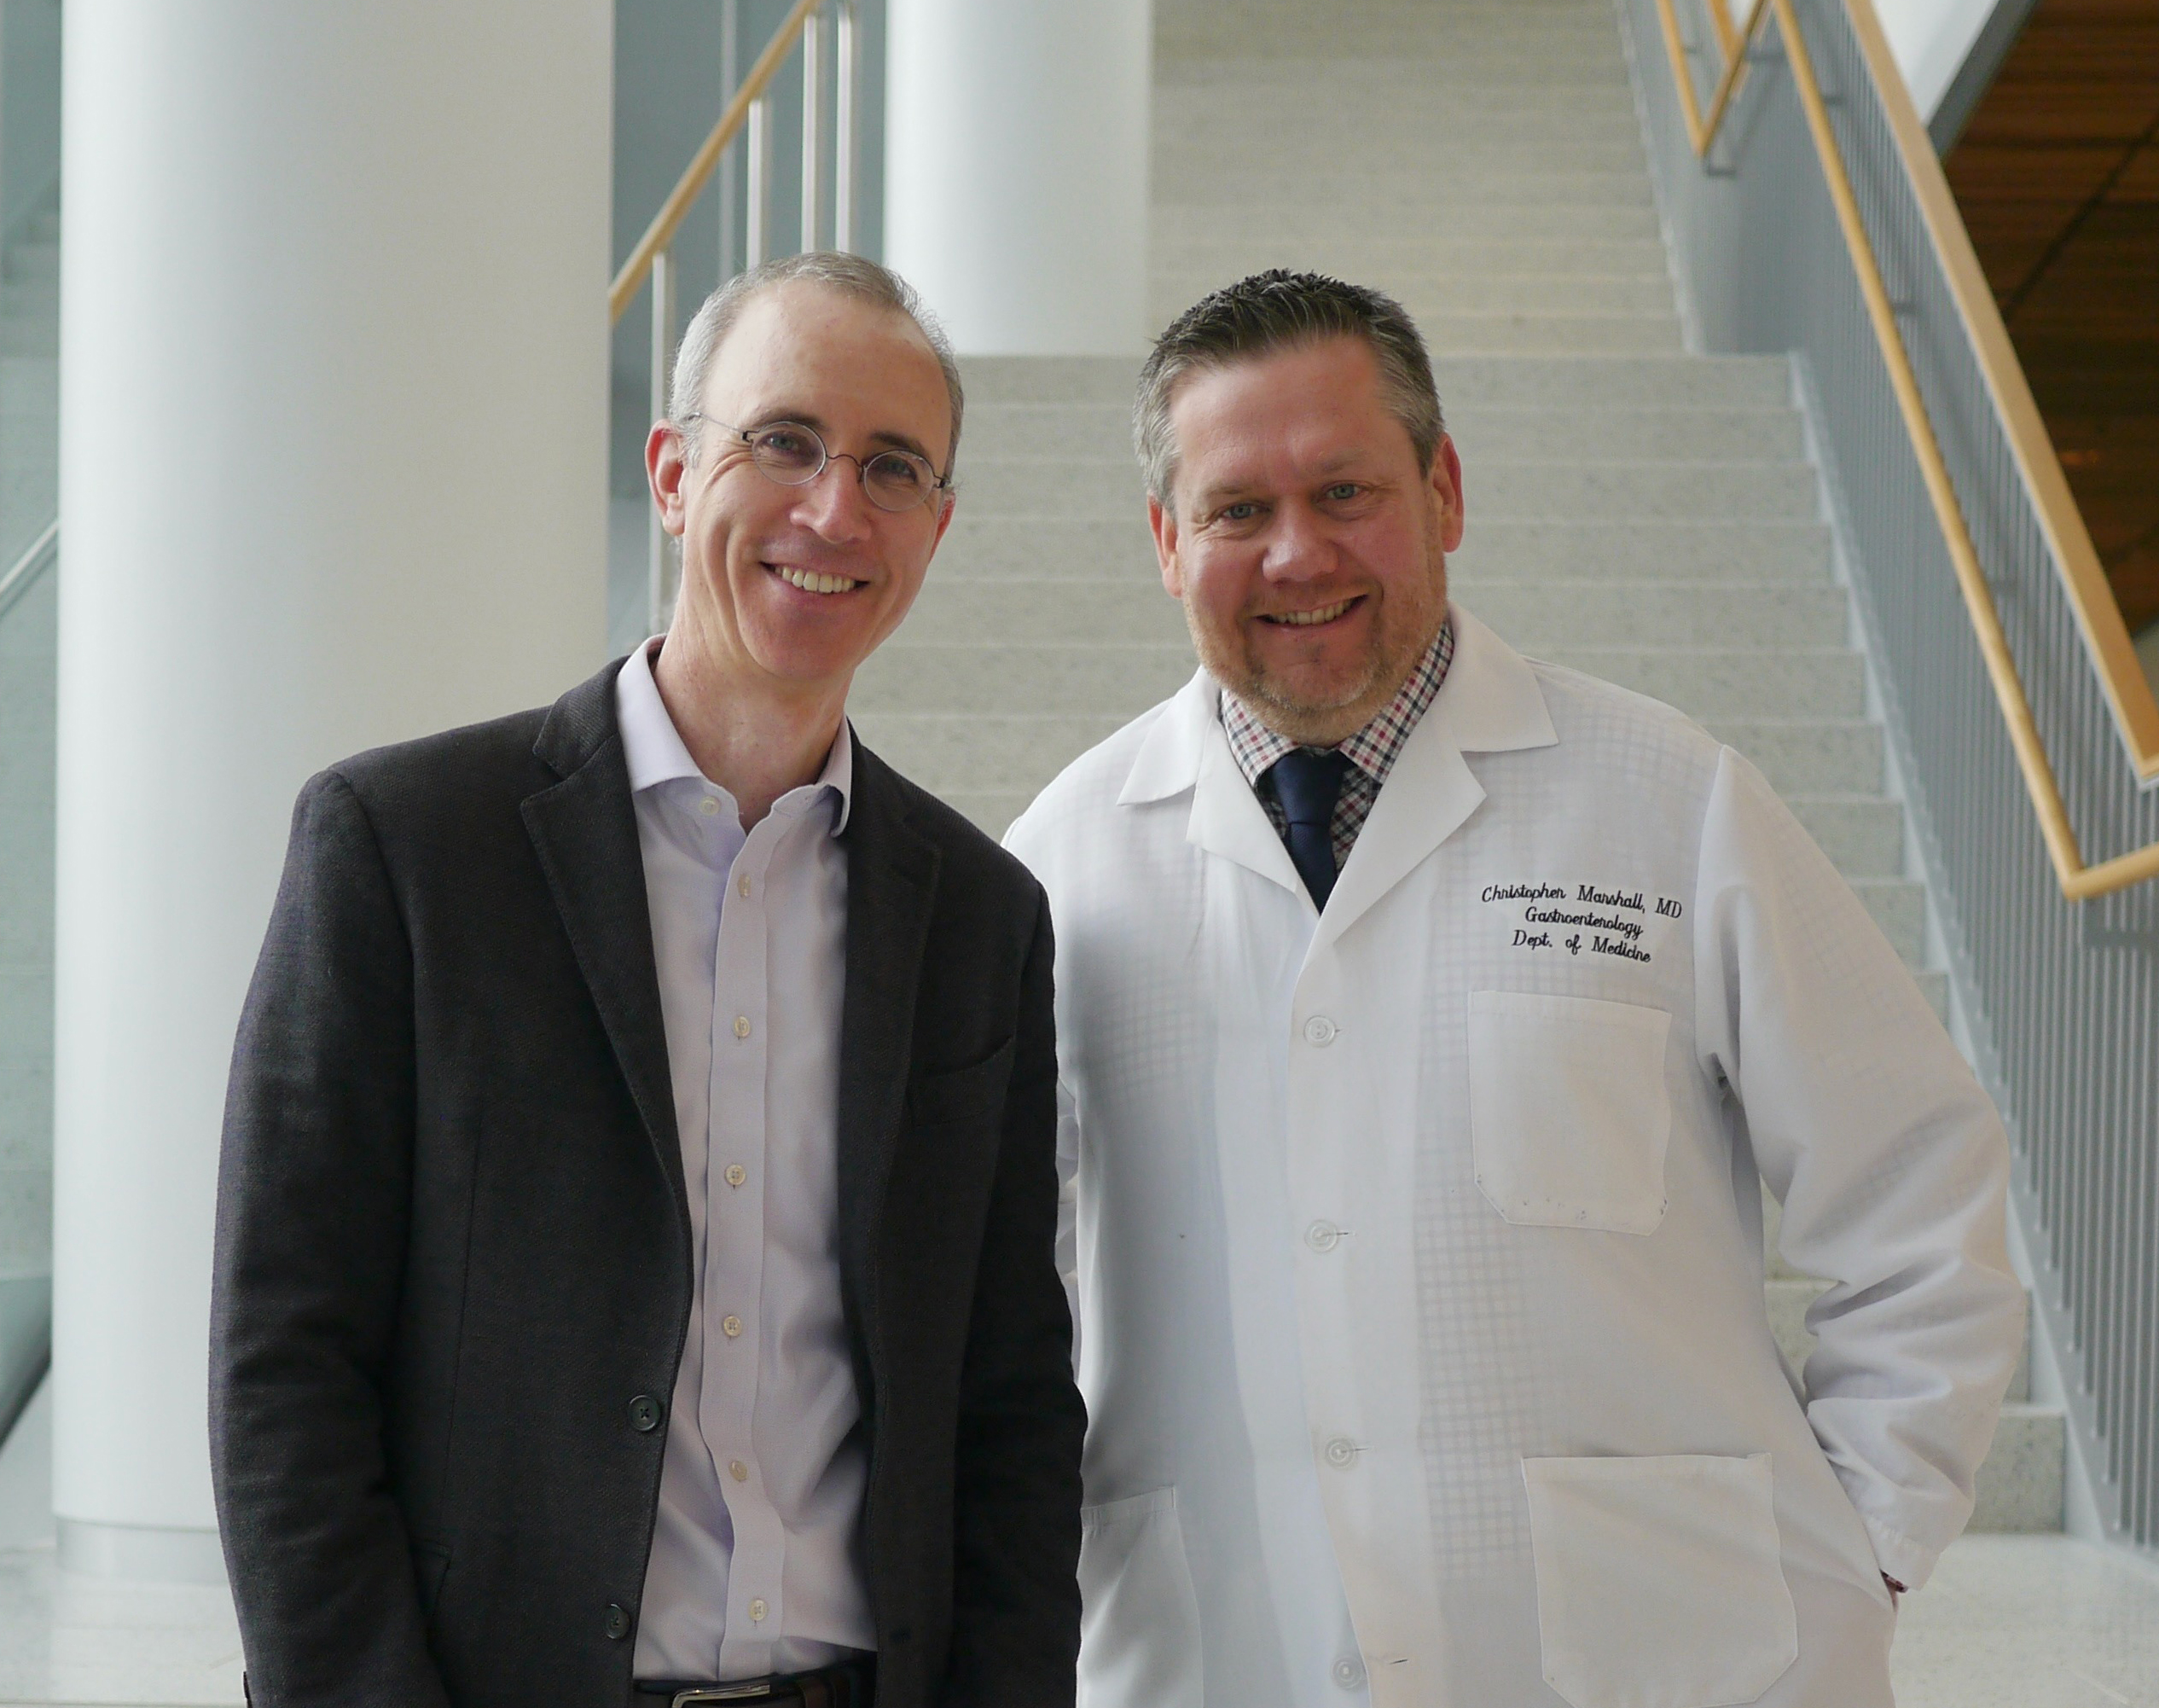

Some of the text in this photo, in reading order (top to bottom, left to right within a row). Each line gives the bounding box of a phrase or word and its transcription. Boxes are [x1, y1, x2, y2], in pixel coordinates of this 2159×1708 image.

[1481, 881, 1683, 919] Christopher Marshall, MD
[1524, 905, 1645, 941] Gastroenterology
[1511, 929, 1651, 963] Dept. of Medicine
